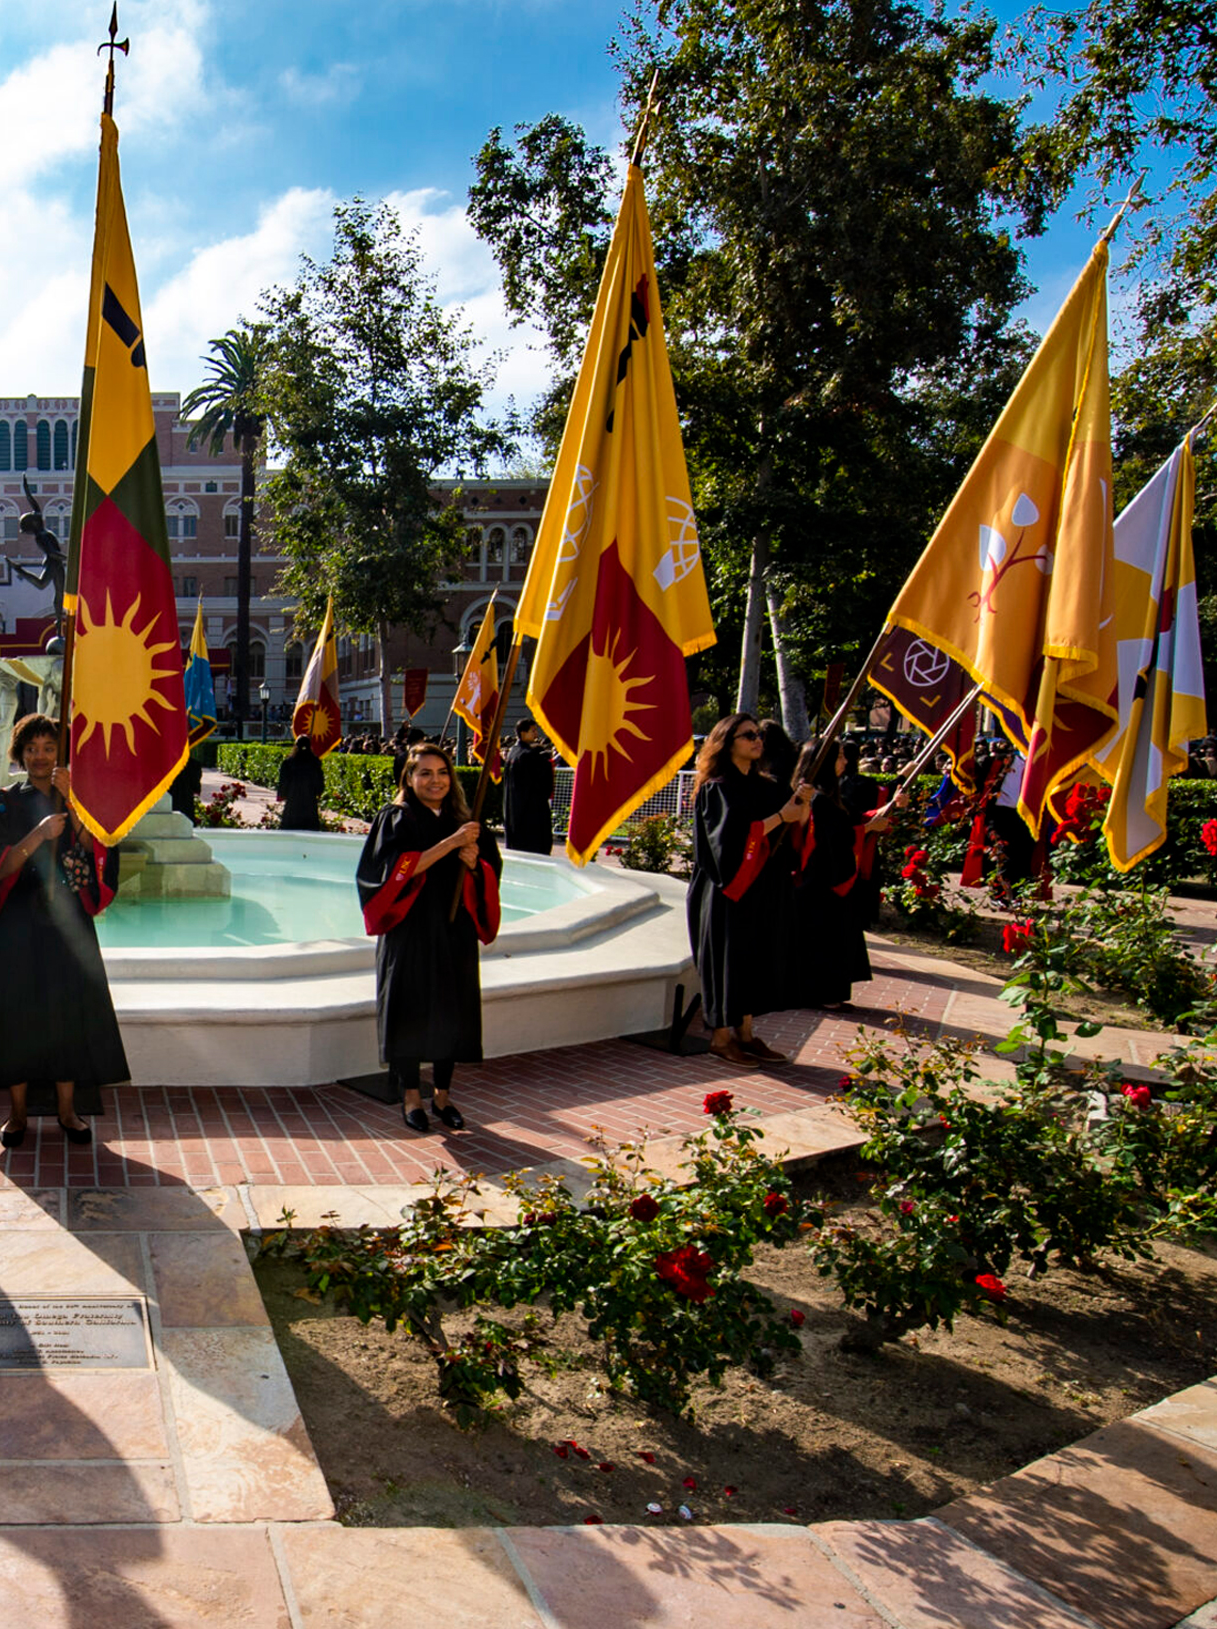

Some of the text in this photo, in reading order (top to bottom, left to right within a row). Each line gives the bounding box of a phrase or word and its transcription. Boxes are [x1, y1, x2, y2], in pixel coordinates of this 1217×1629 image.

[34, 1313, 68, 1321] Omega
[72, 1313, 124, 1321] Fraternity
[34, 1319, 81, 1327] Southern
[85, 1319, 137, 1327] California
